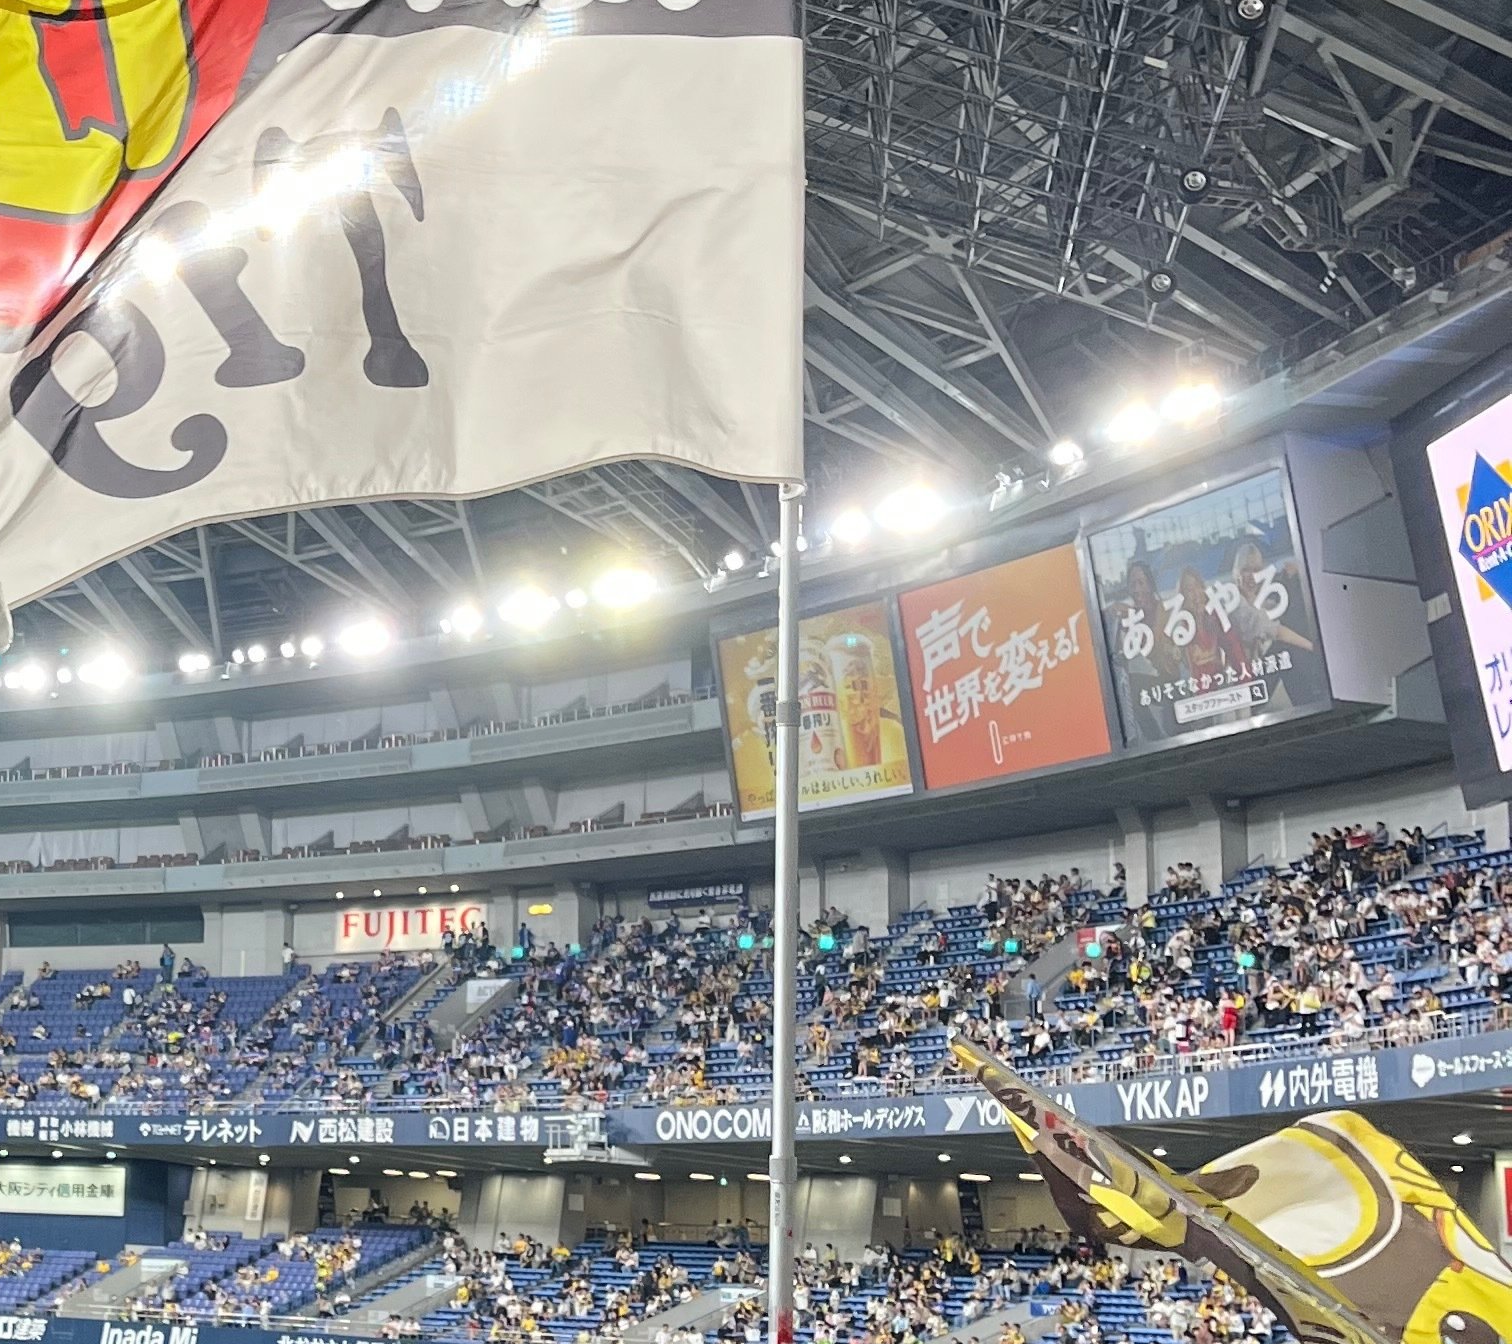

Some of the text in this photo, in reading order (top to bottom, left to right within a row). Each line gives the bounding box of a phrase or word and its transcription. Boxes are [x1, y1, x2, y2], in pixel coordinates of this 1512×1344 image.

[1121, 564, 1289, 660] あるやろ
[915, 599, 994, 693] 声で
[342, 905, 484, 945] FUJITEC
[1289, 1055, 1380, 1108] 内外電機
[1116, 1078, 1174, 1123] YKK
[183, 1119, 262, 1143] テレネット
[318, 1117, 395, 1144] 西松建設
[452, 1115, 539, 1143] 日本建物
[656, 1106, 772, 1141] ONOCOM
[811, 1105, 927, 1136] 阪和ホールディングス
